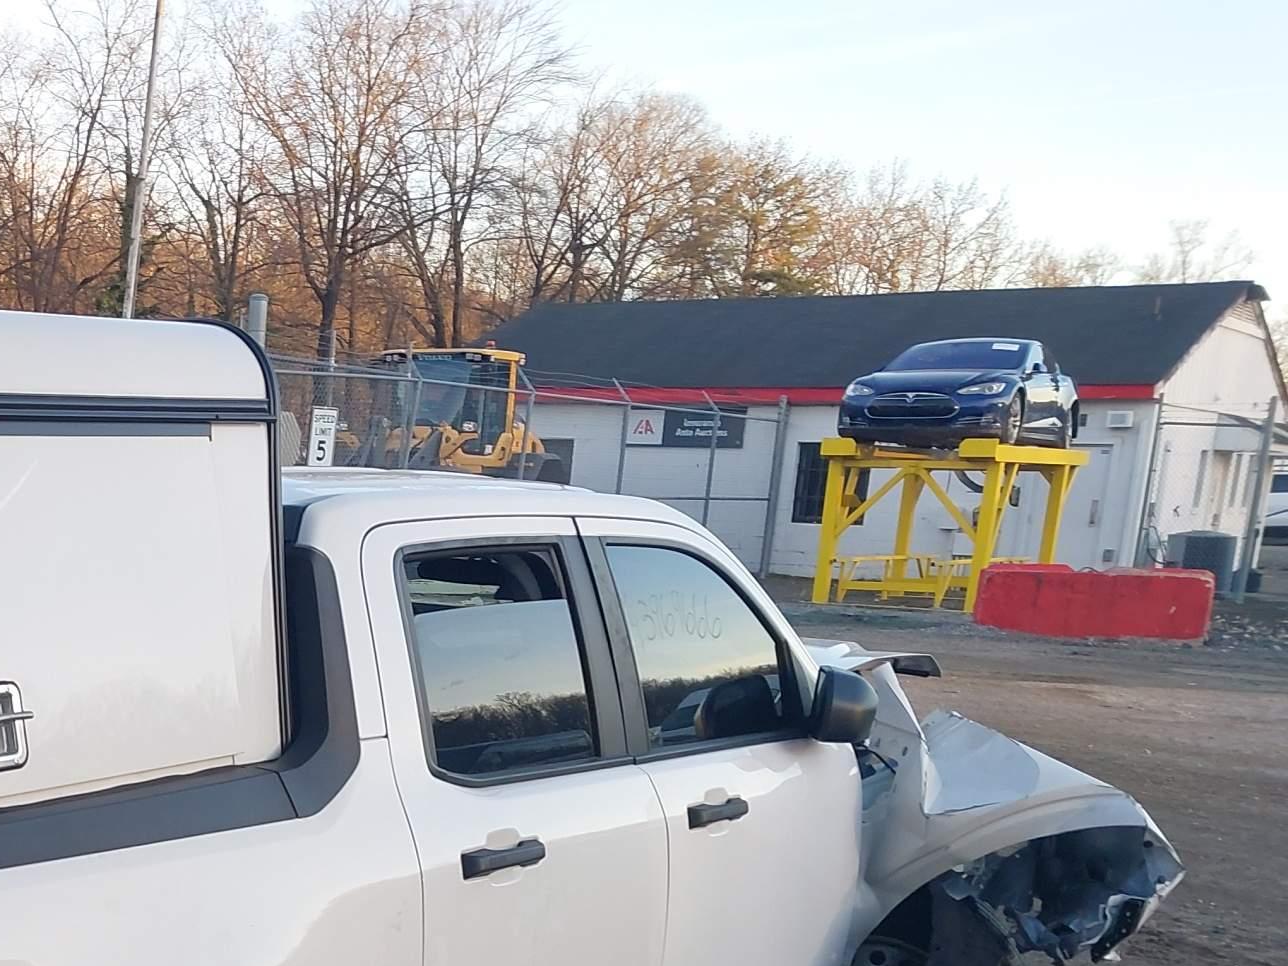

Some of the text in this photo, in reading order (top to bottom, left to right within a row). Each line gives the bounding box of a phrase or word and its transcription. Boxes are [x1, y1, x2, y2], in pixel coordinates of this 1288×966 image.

[314, 414, 336, 424] SPEED
[314, 427, 333, 436] LIMIT
[316, 440, 326, 462] 5
